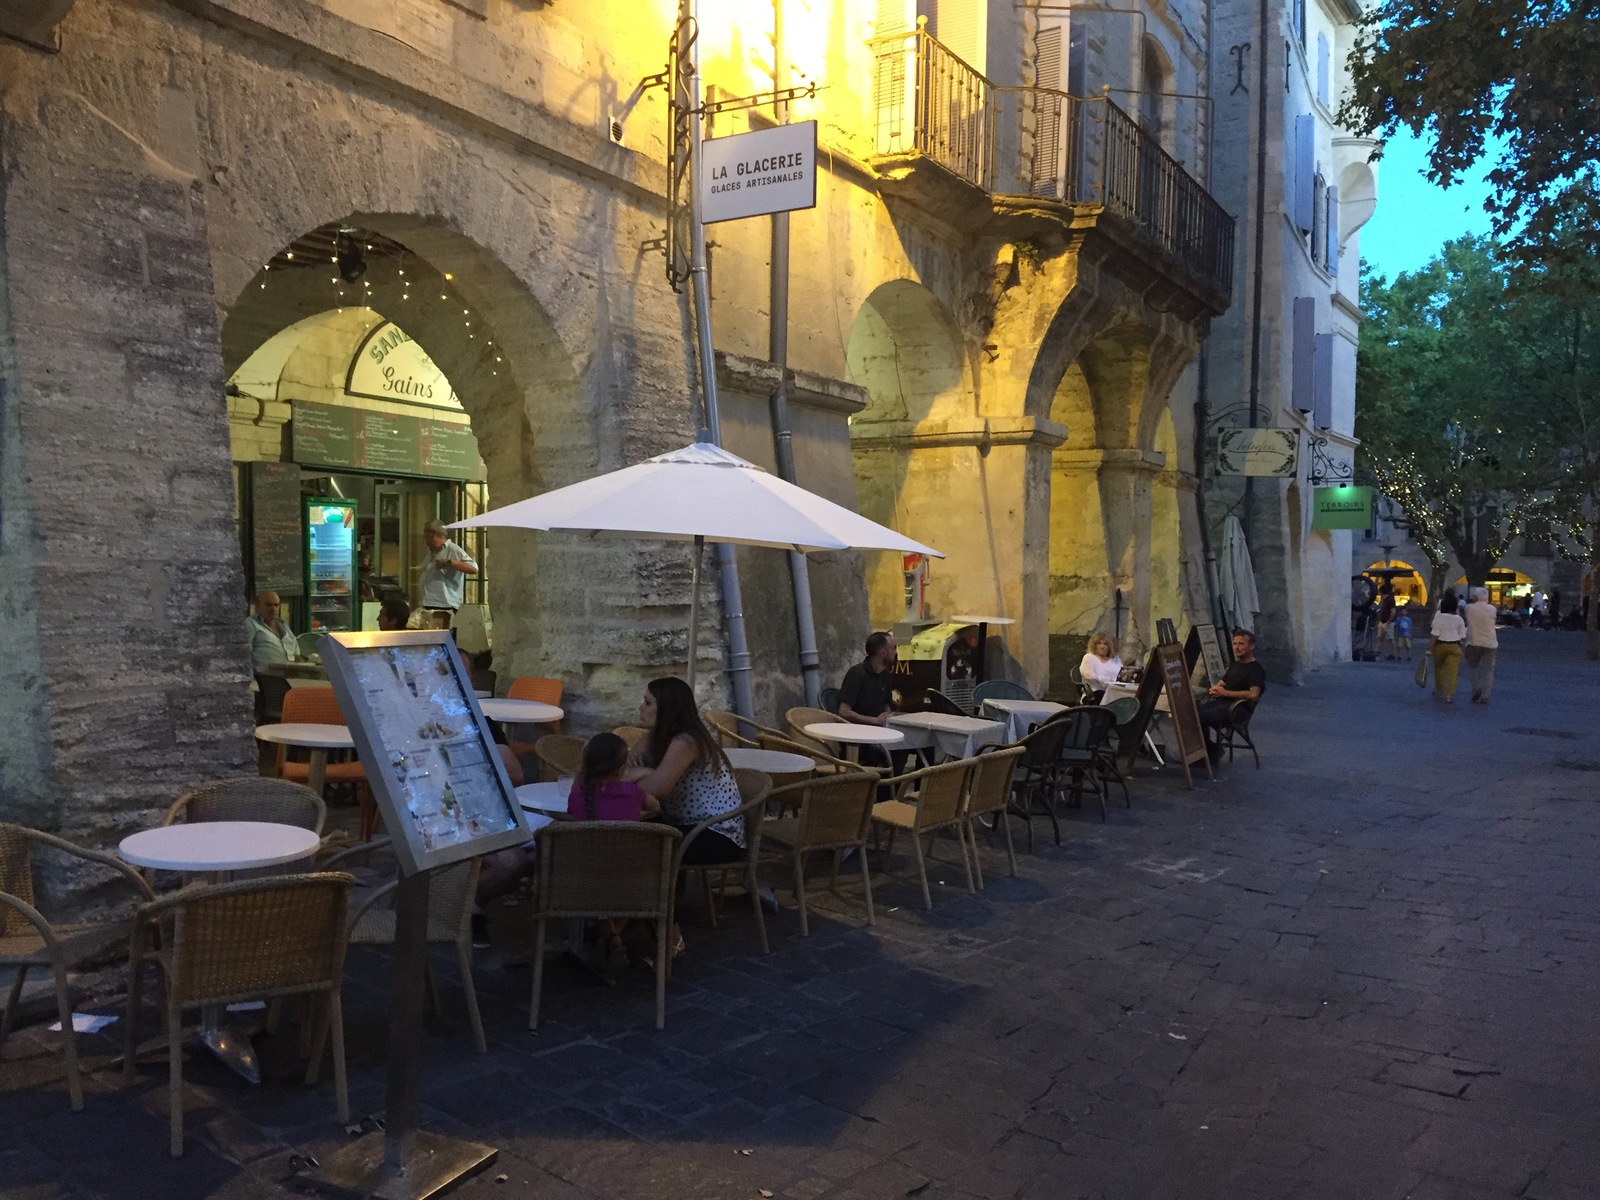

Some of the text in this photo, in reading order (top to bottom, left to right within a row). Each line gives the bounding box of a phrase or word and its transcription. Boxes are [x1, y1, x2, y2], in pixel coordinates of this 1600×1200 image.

[712, 152, 803, 180] LA GLACERIE
[711, 171, 803, 194] GLACES ARTISANALES
[382, 366, 433, 399] Gains
[1320, 501, 1365, 509] TERROIRS
